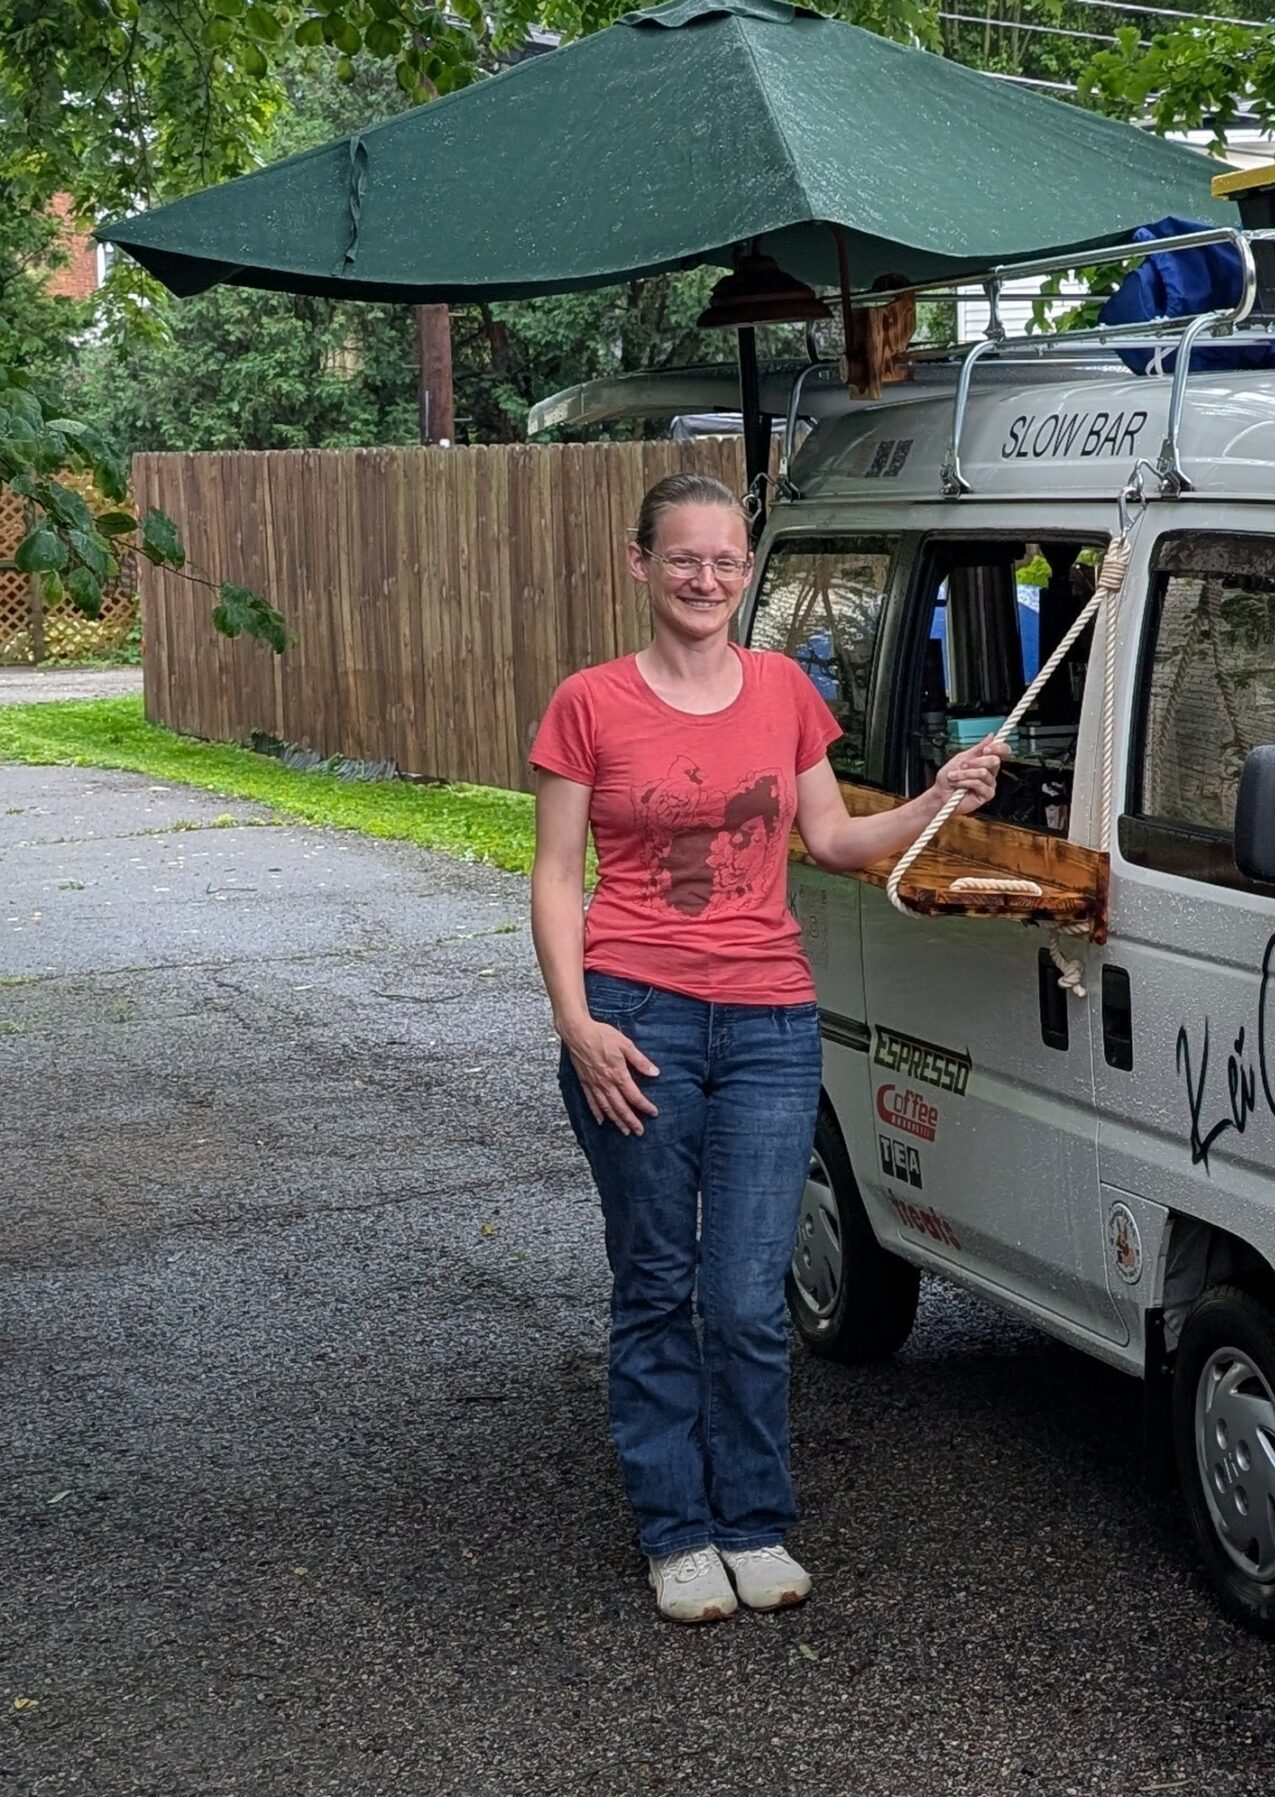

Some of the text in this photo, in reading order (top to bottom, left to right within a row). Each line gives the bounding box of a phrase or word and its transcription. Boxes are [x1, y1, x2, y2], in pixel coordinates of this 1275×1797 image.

[1001, 411, 1148, 458] SLOW BAR
[874, 1026, 970, 1096] ESPRESSO
[877, 1084, 938, 1128] Coffee
[879, 1137, 921, 1177] TEA
